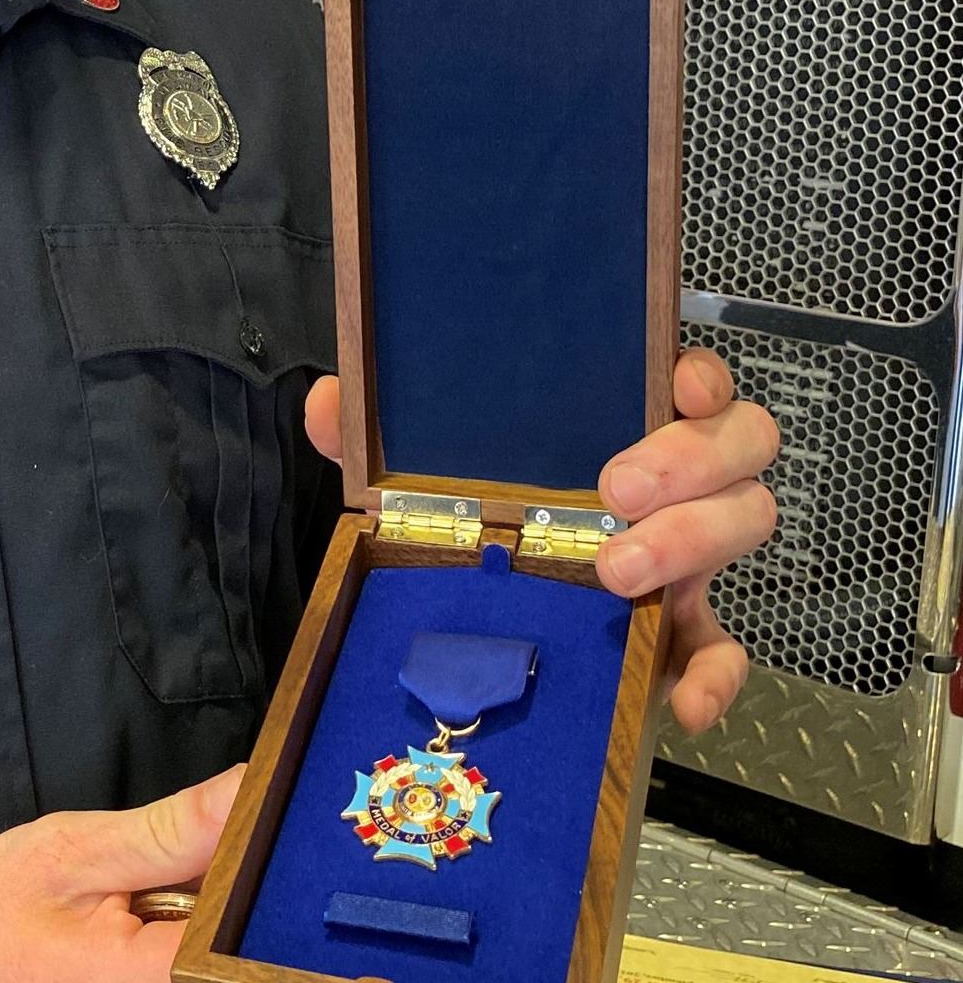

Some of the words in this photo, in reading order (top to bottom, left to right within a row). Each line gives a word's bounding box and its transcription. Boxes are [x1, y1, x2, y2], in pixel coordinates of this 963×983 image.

[371, 809, 400, 839] MEDAL
[405, 833, 416, 843] of
[421, 821, 462, 843] VALOR
